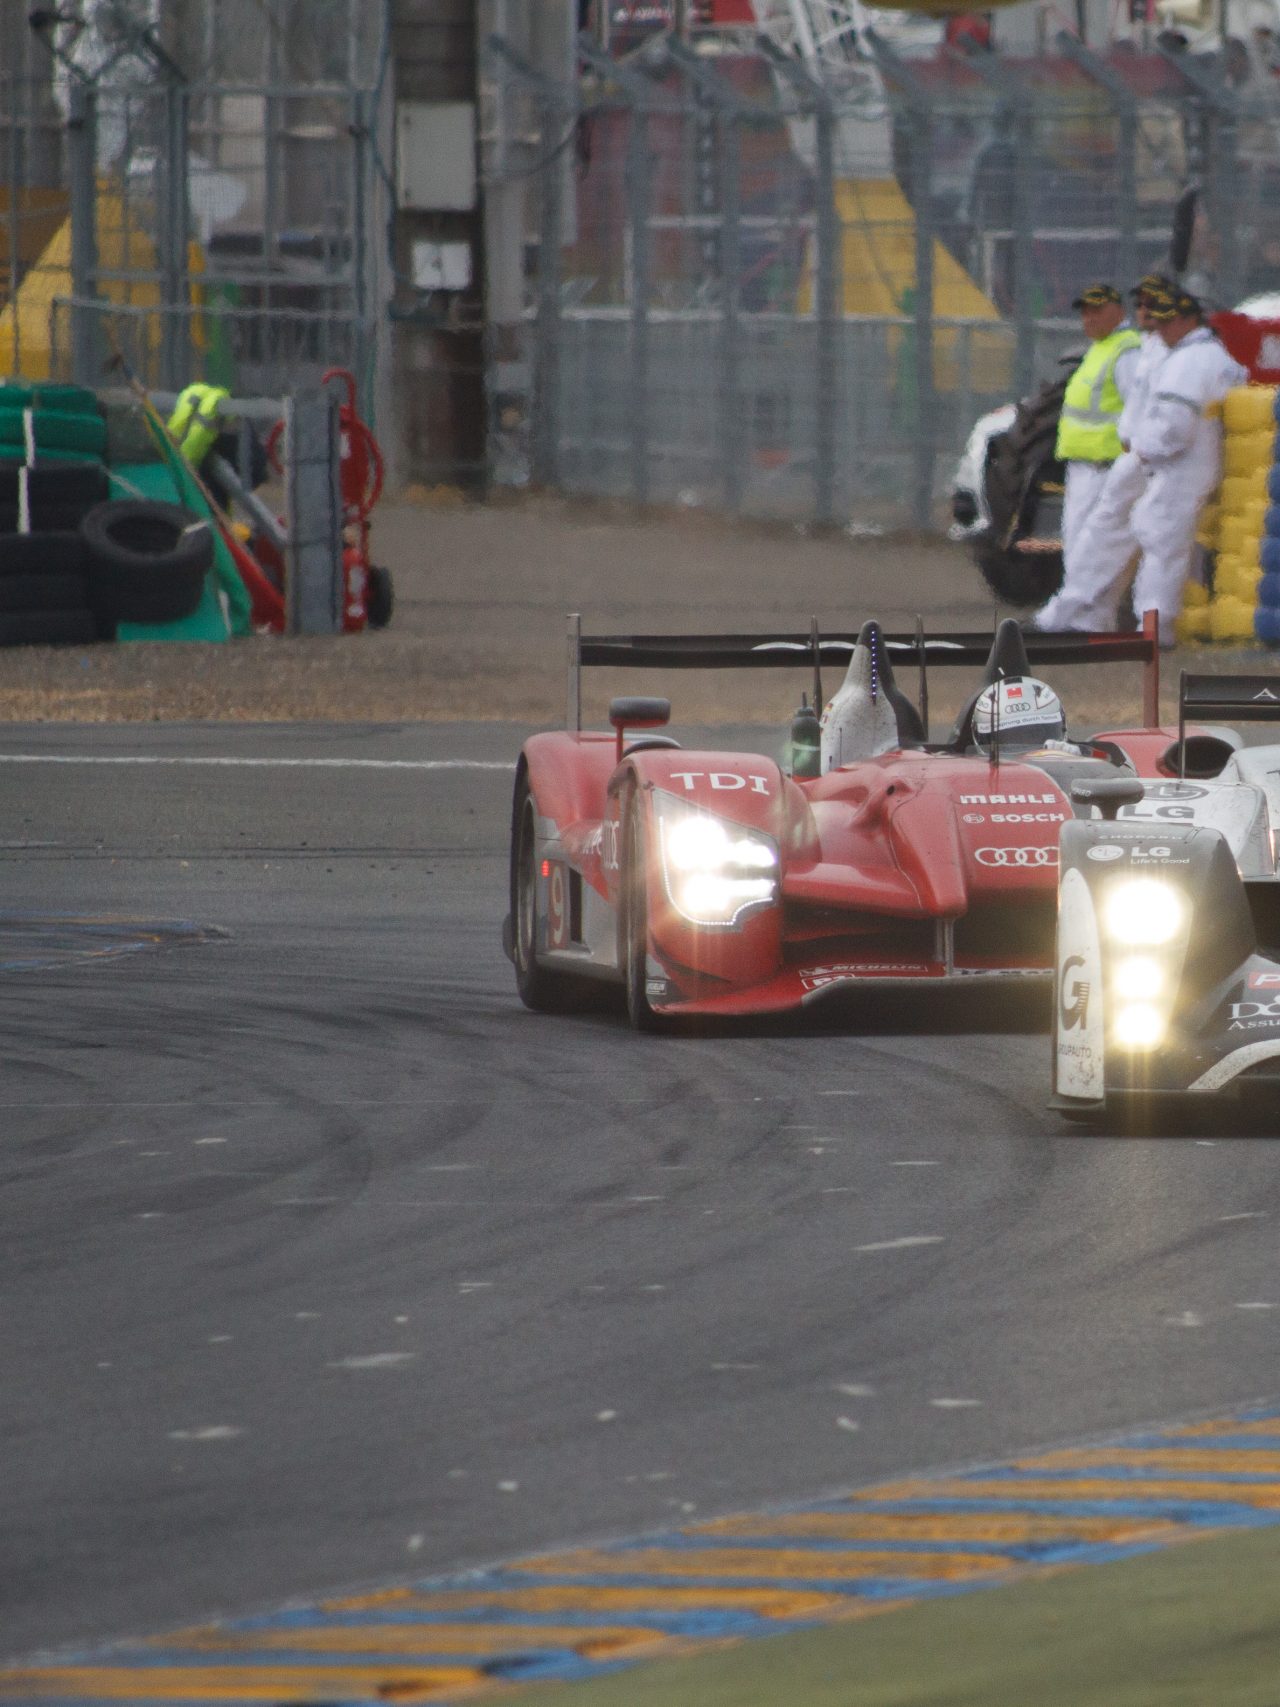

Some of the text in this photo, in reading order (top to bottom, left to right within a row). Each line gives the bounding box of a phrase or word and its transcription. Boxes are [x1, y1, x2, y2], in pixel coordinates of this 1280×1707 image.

[670, 772, 770, 795] TDI
[960, 793, 1057, 804] MAHLE
[990, 813, 1065, 822] BOSCH
[1123, 805, 1195, 819] LG
[1131, 846, 1171, 857] LG
[1130, 857, 1159, 865] Life's
